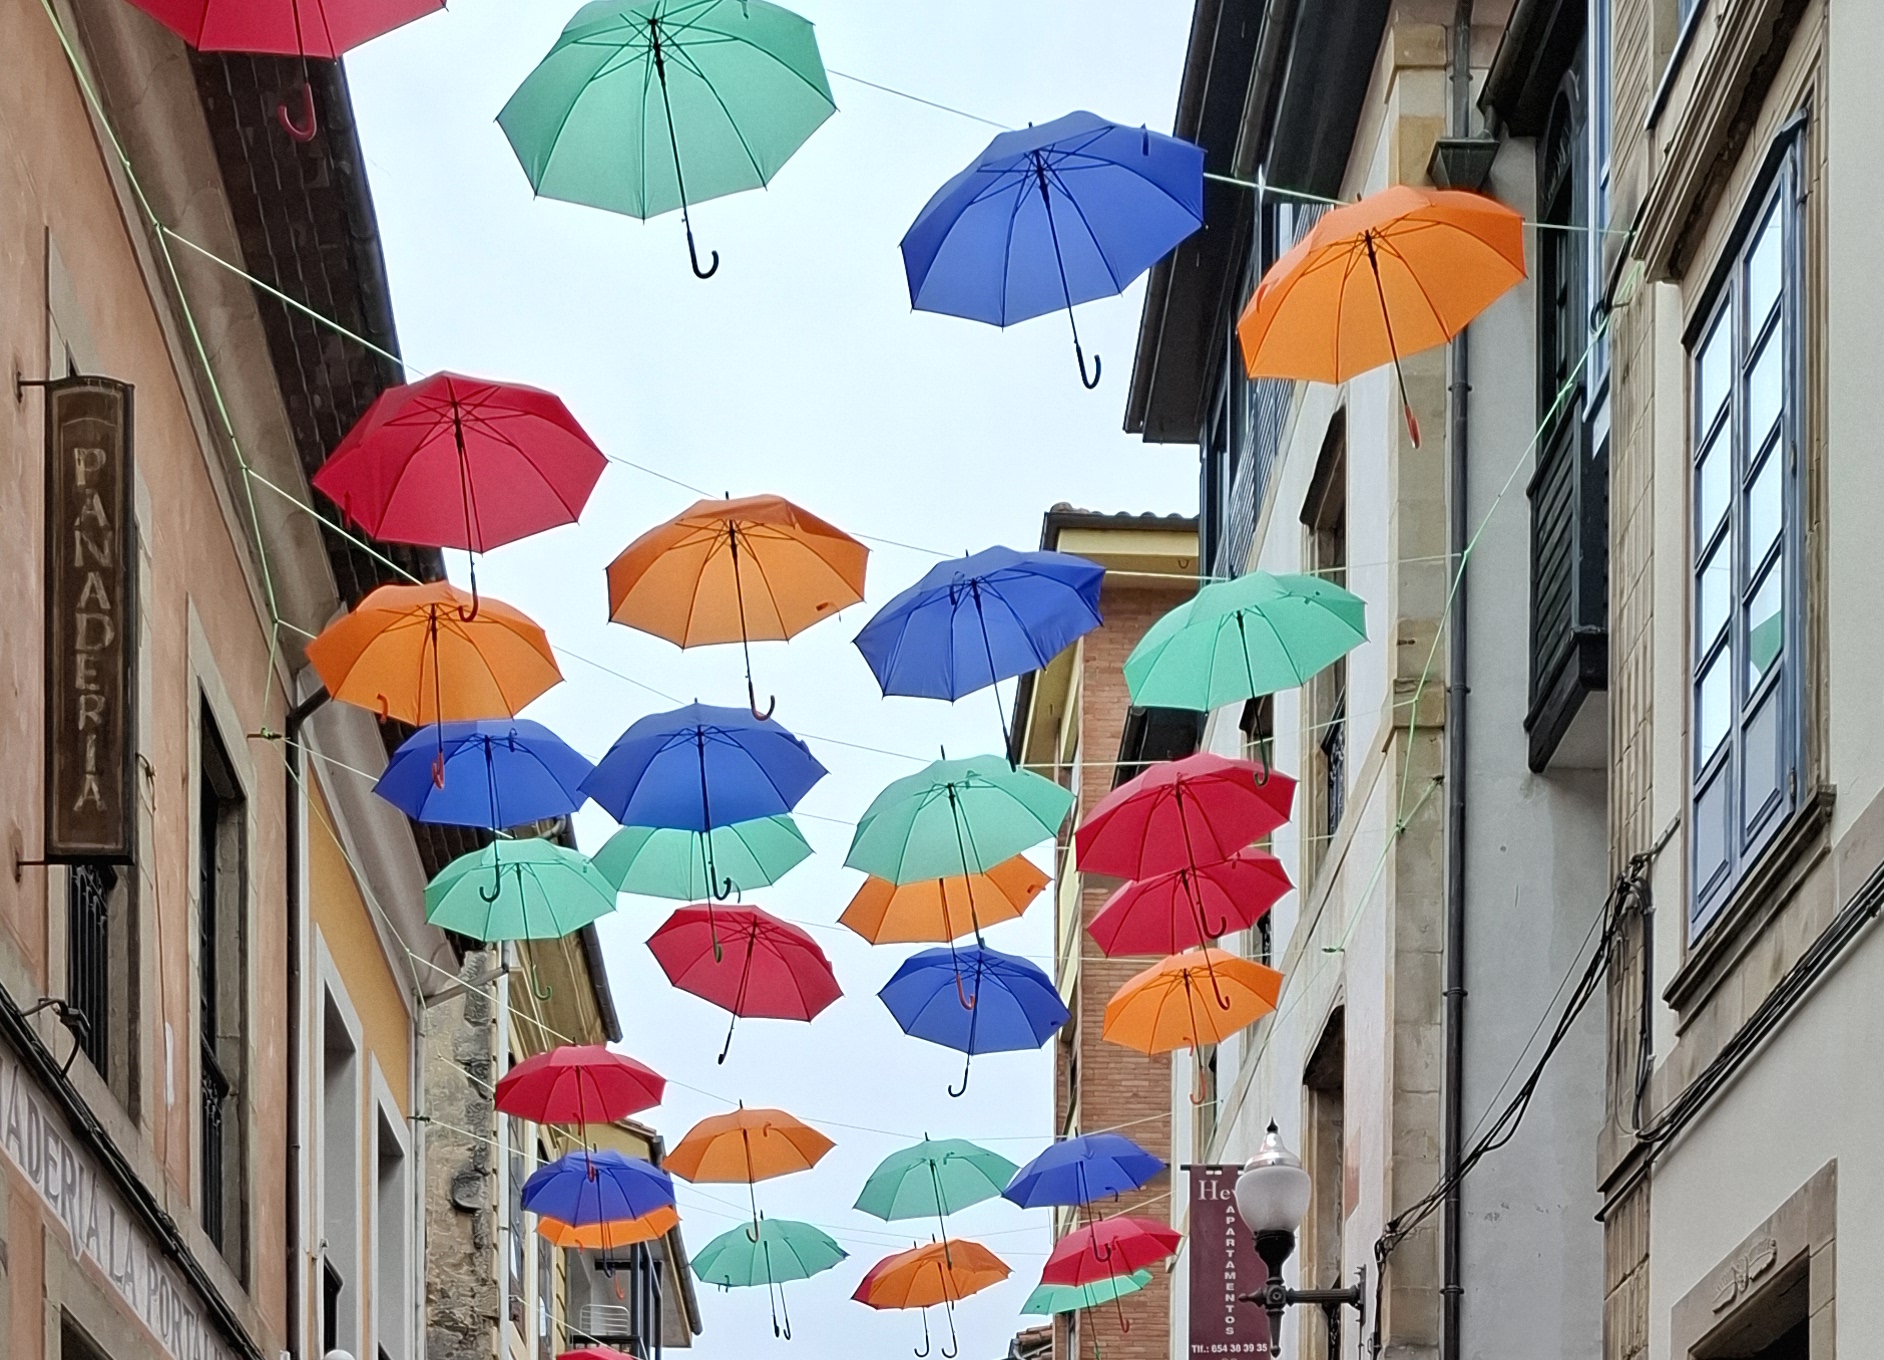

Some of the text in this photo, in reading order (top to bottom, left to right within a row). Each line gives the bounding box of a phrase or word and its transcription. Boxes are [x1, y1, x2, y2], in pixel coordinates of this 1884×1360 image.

[1198, 1180, 1236, 1200] He
[109, 1203, 138, 1312] LA
[1224, 1205, 1236, 1335] APARTAMENTOS
[1256, 1343, 1268, 1352] 35
